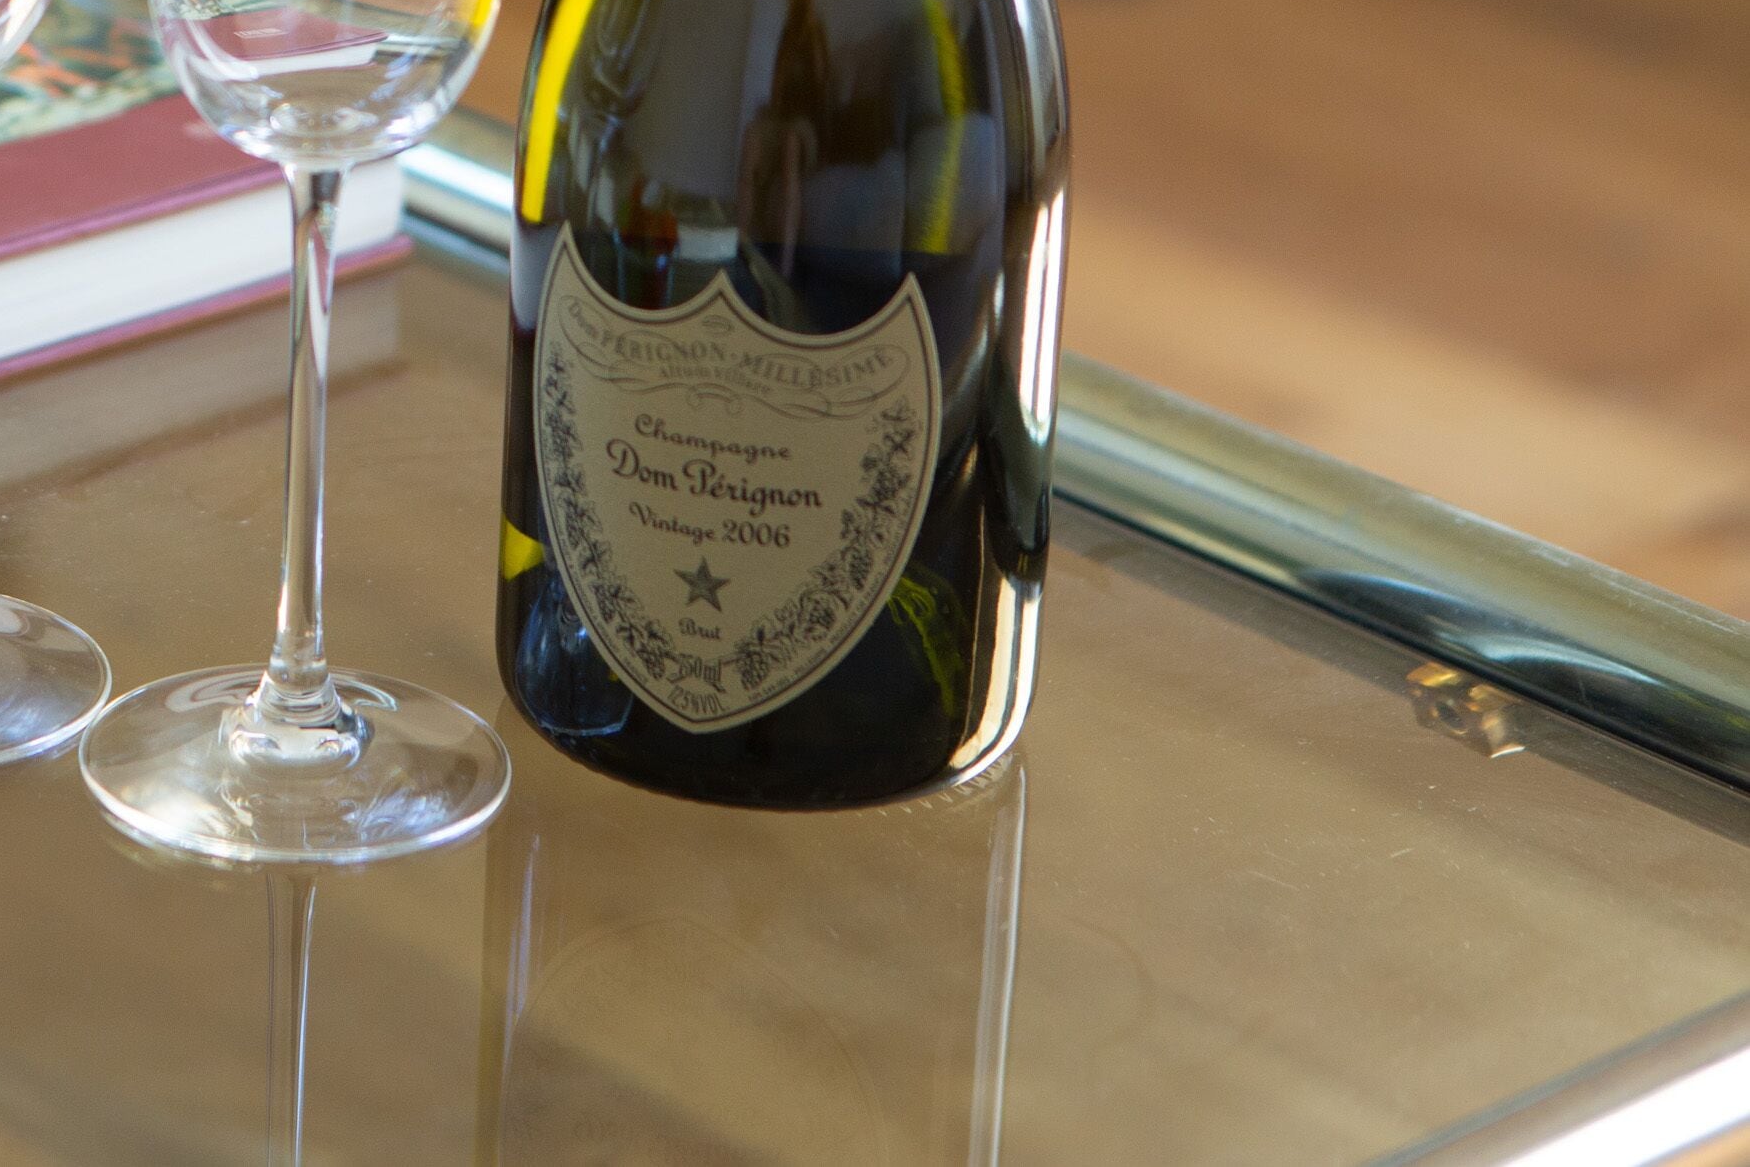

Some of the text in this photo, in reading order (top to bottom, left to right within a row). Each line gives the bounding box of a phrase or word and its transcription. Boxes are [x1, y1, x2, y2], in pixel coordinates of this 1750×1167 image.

[634, 413, 792, 465] Champagne
[606, 438, 822, 517] Dom Pérignon
[629, 501, 791, 549] Vintage 2006
[678, 617, 721, 640] Brut
